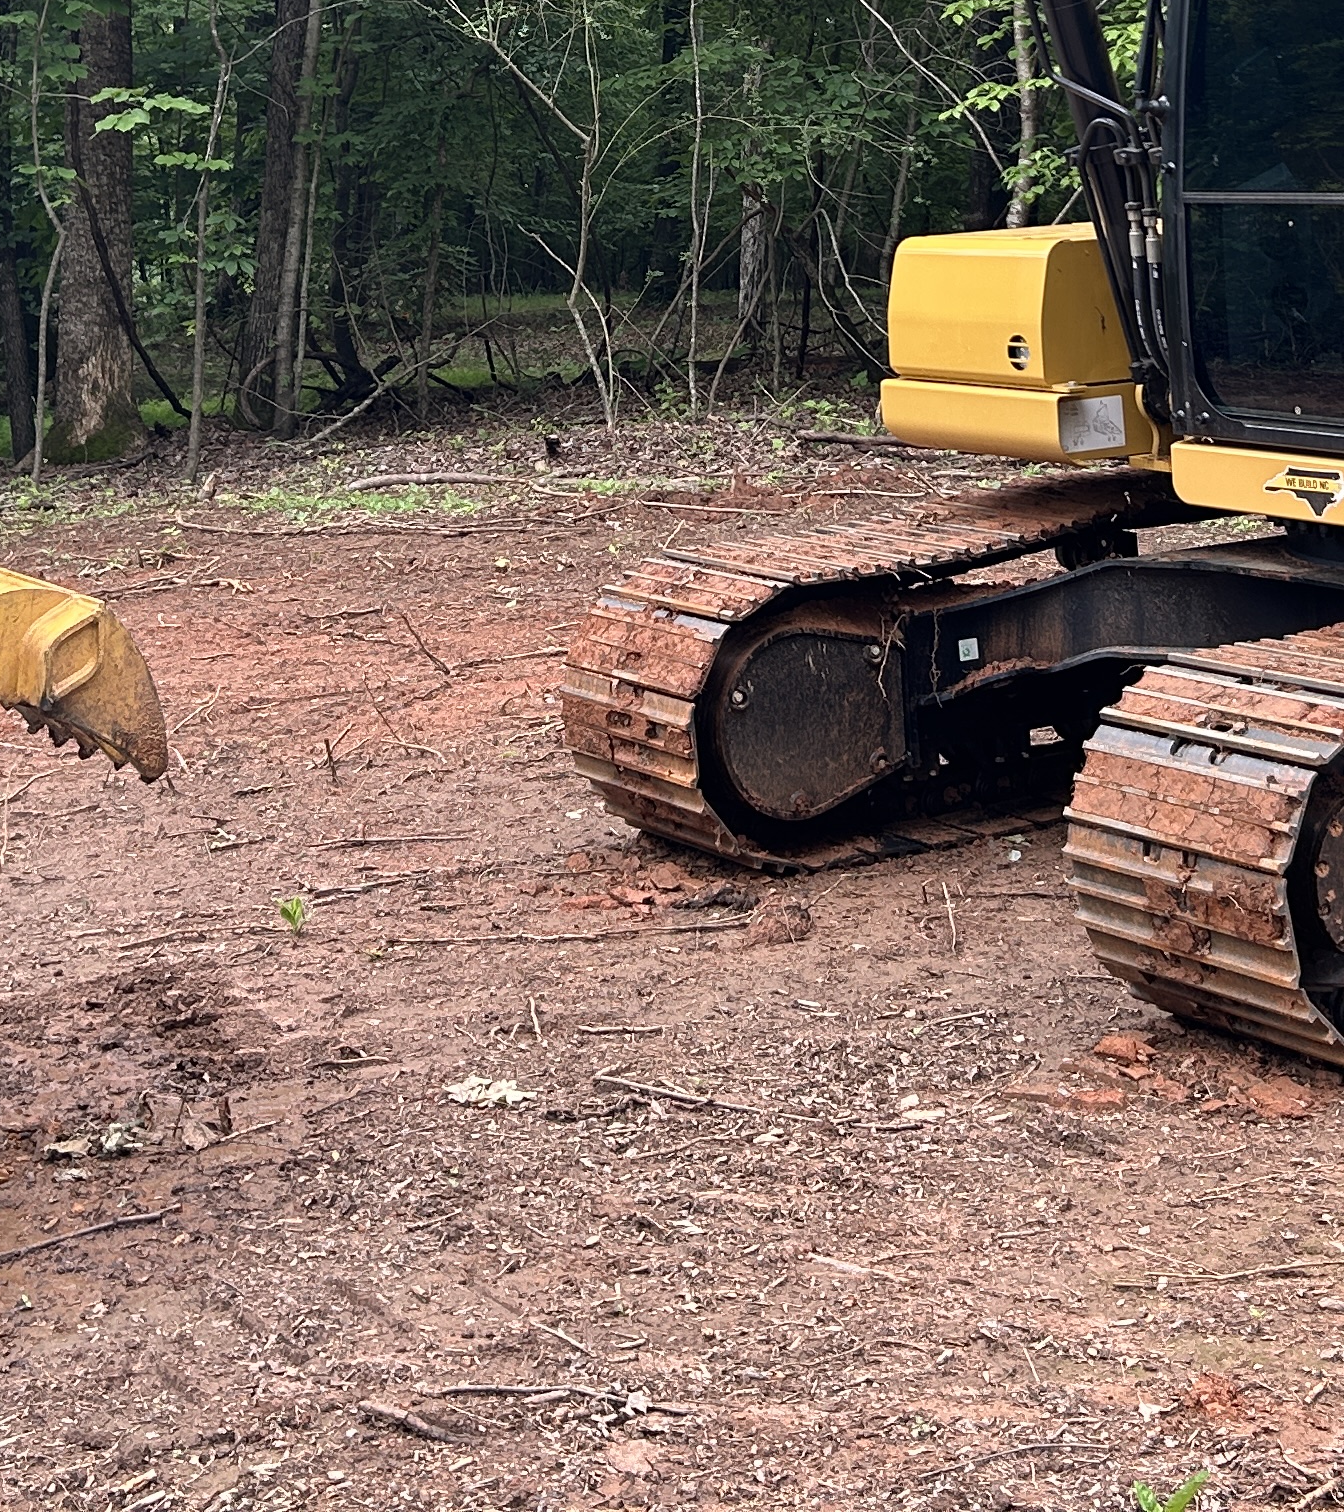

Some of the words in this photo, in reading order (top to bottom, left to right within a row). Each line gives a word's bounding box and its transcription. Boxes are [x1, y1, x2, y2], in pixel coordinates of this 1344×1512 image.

[1285, 477, 1297, 488] WE
[1298, 478, 1318, 490] BUILD
[1319, 480, 1330, 491] NC
